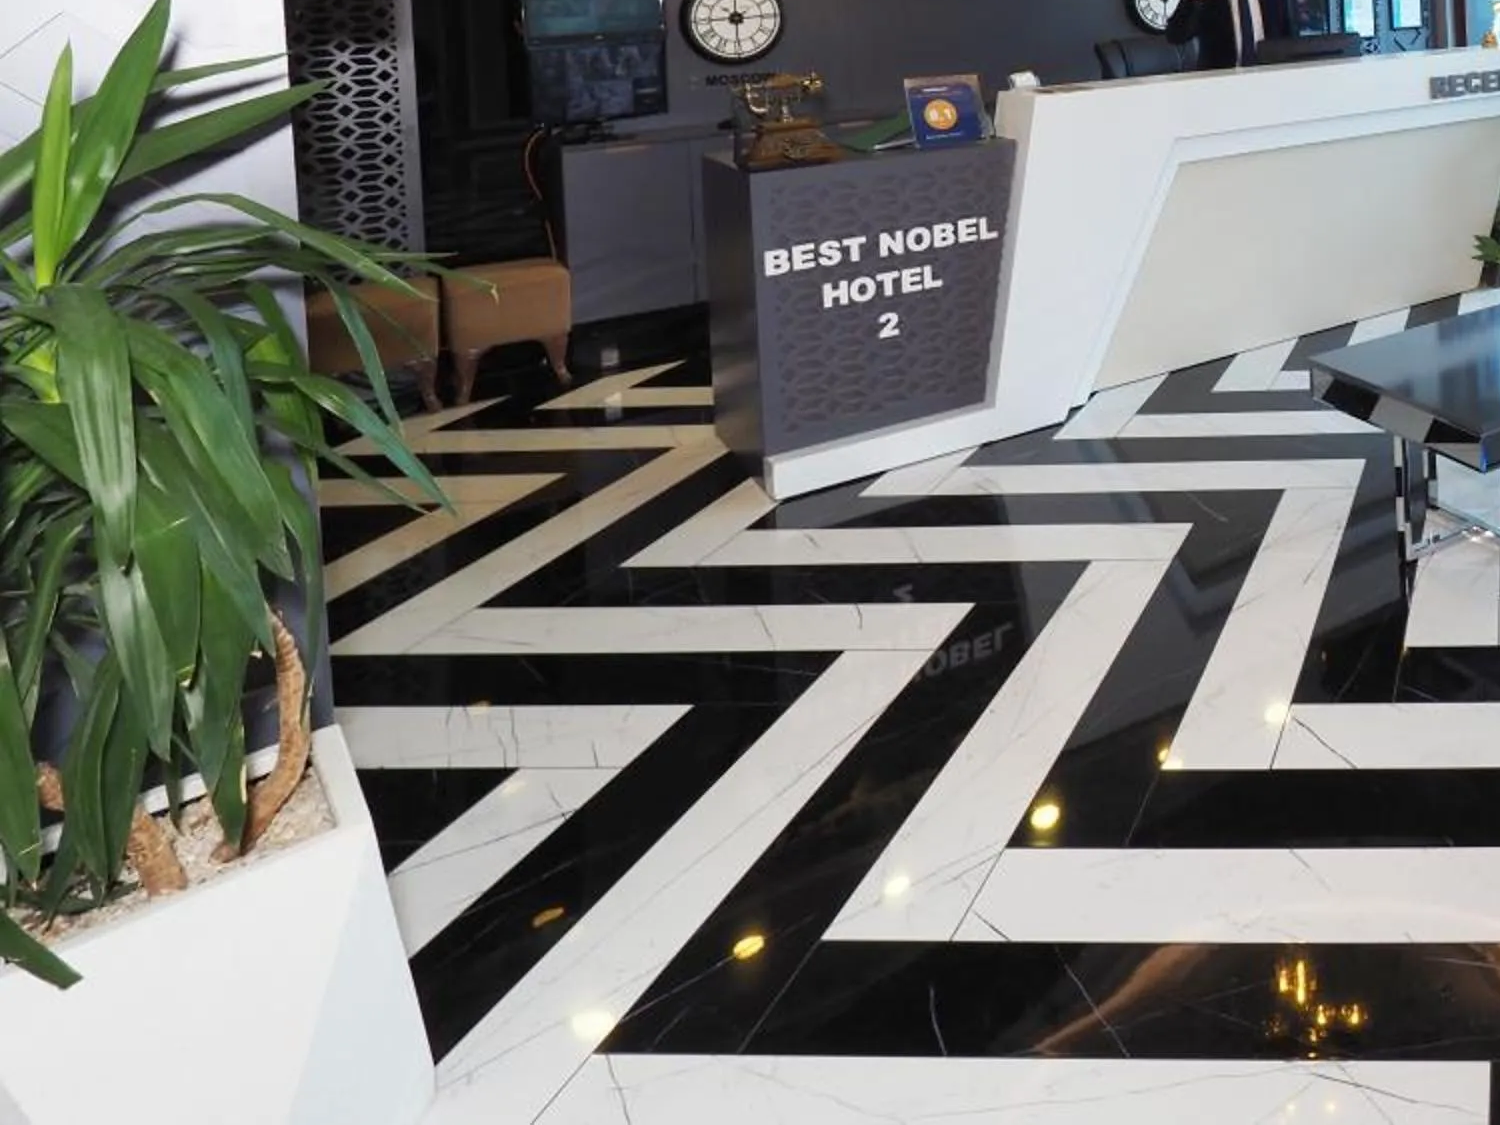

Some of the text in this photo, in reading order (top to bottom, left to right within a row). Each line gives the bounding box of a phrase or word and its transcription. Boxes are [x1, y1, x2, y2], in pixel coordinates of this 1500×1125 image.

[763, 217, 999, 277] BEST NOBEL
[821, 264, 944, 308] HOTEL
[878, 312, 900, 339] 2
